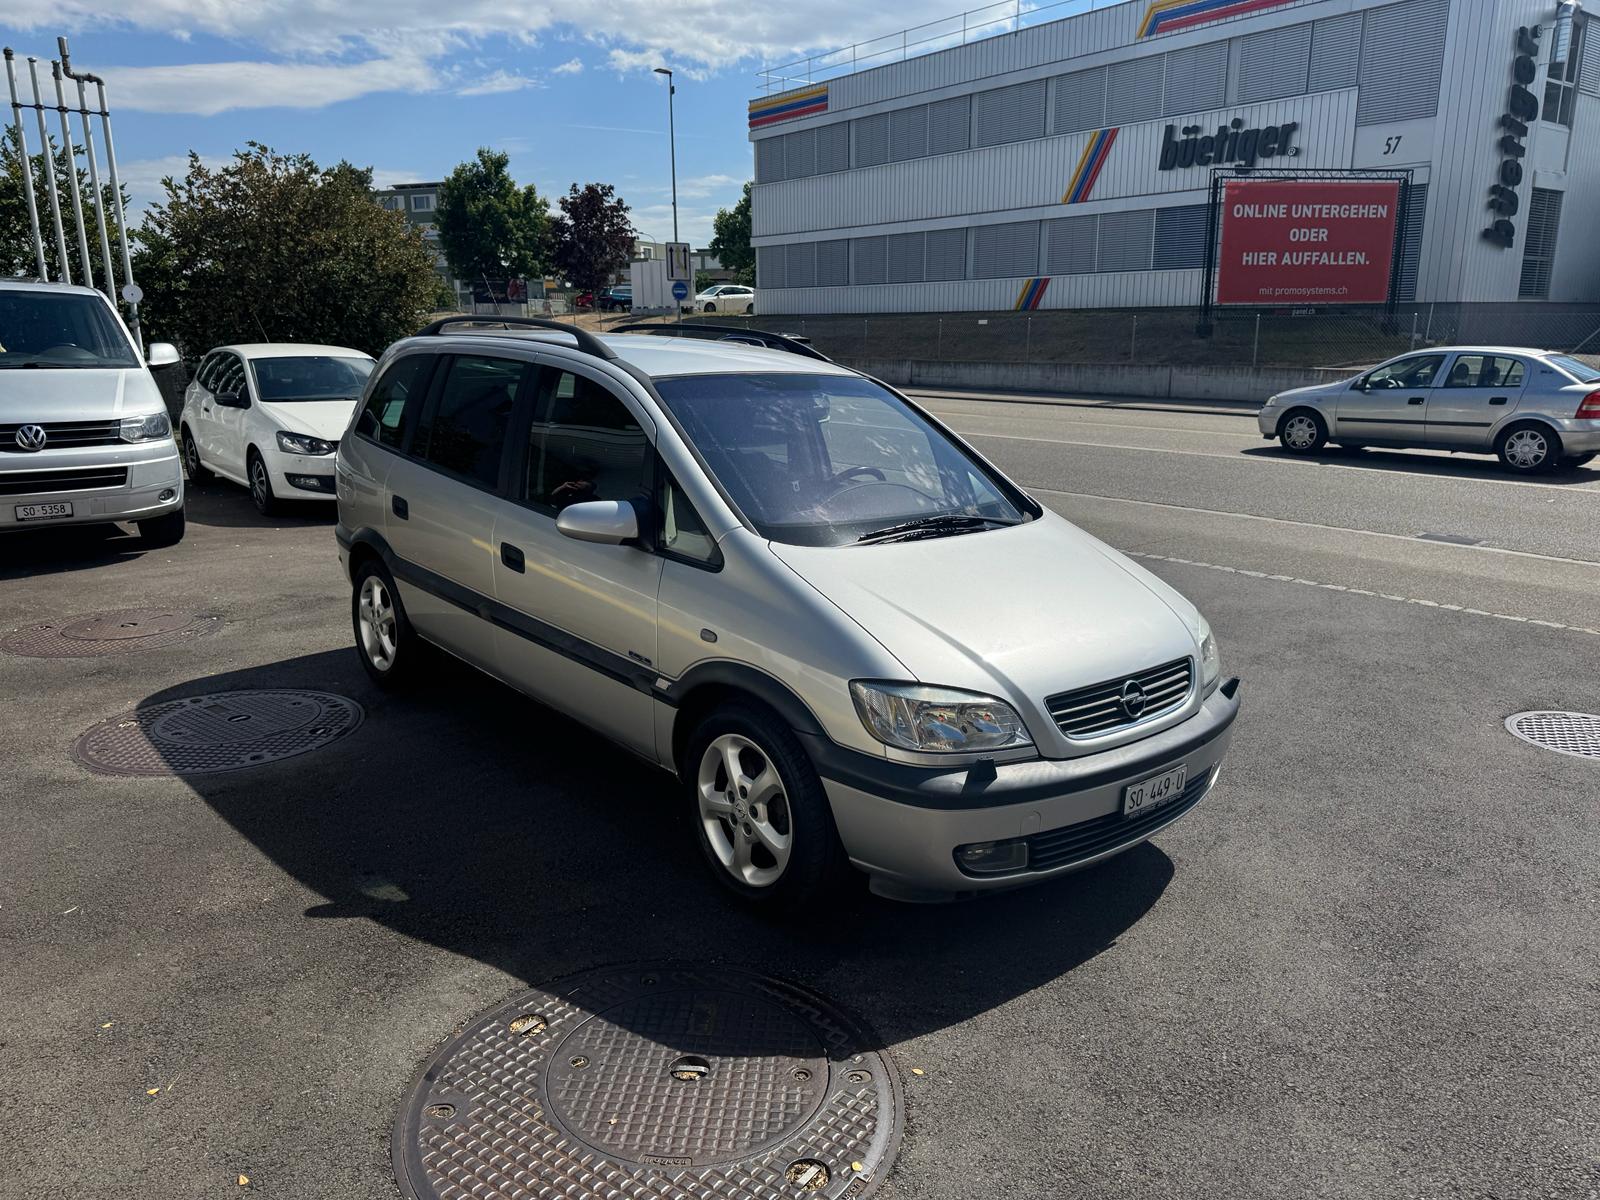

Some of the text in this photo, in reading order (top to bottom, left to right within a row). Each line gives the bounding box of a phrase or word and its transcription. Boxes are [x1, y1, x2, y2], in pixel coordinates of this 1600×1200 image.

[1383, 136, 1402, 155] 57
[1233, 204, 1388, 219] ONLINE UNTERGEHEN
[1289, 228, 1329, 242] ODER
[1242, 252, 1370, 266] HIER AUFFALLEN.
[1259, 286, 1348, 298] mit promosystems.ch
